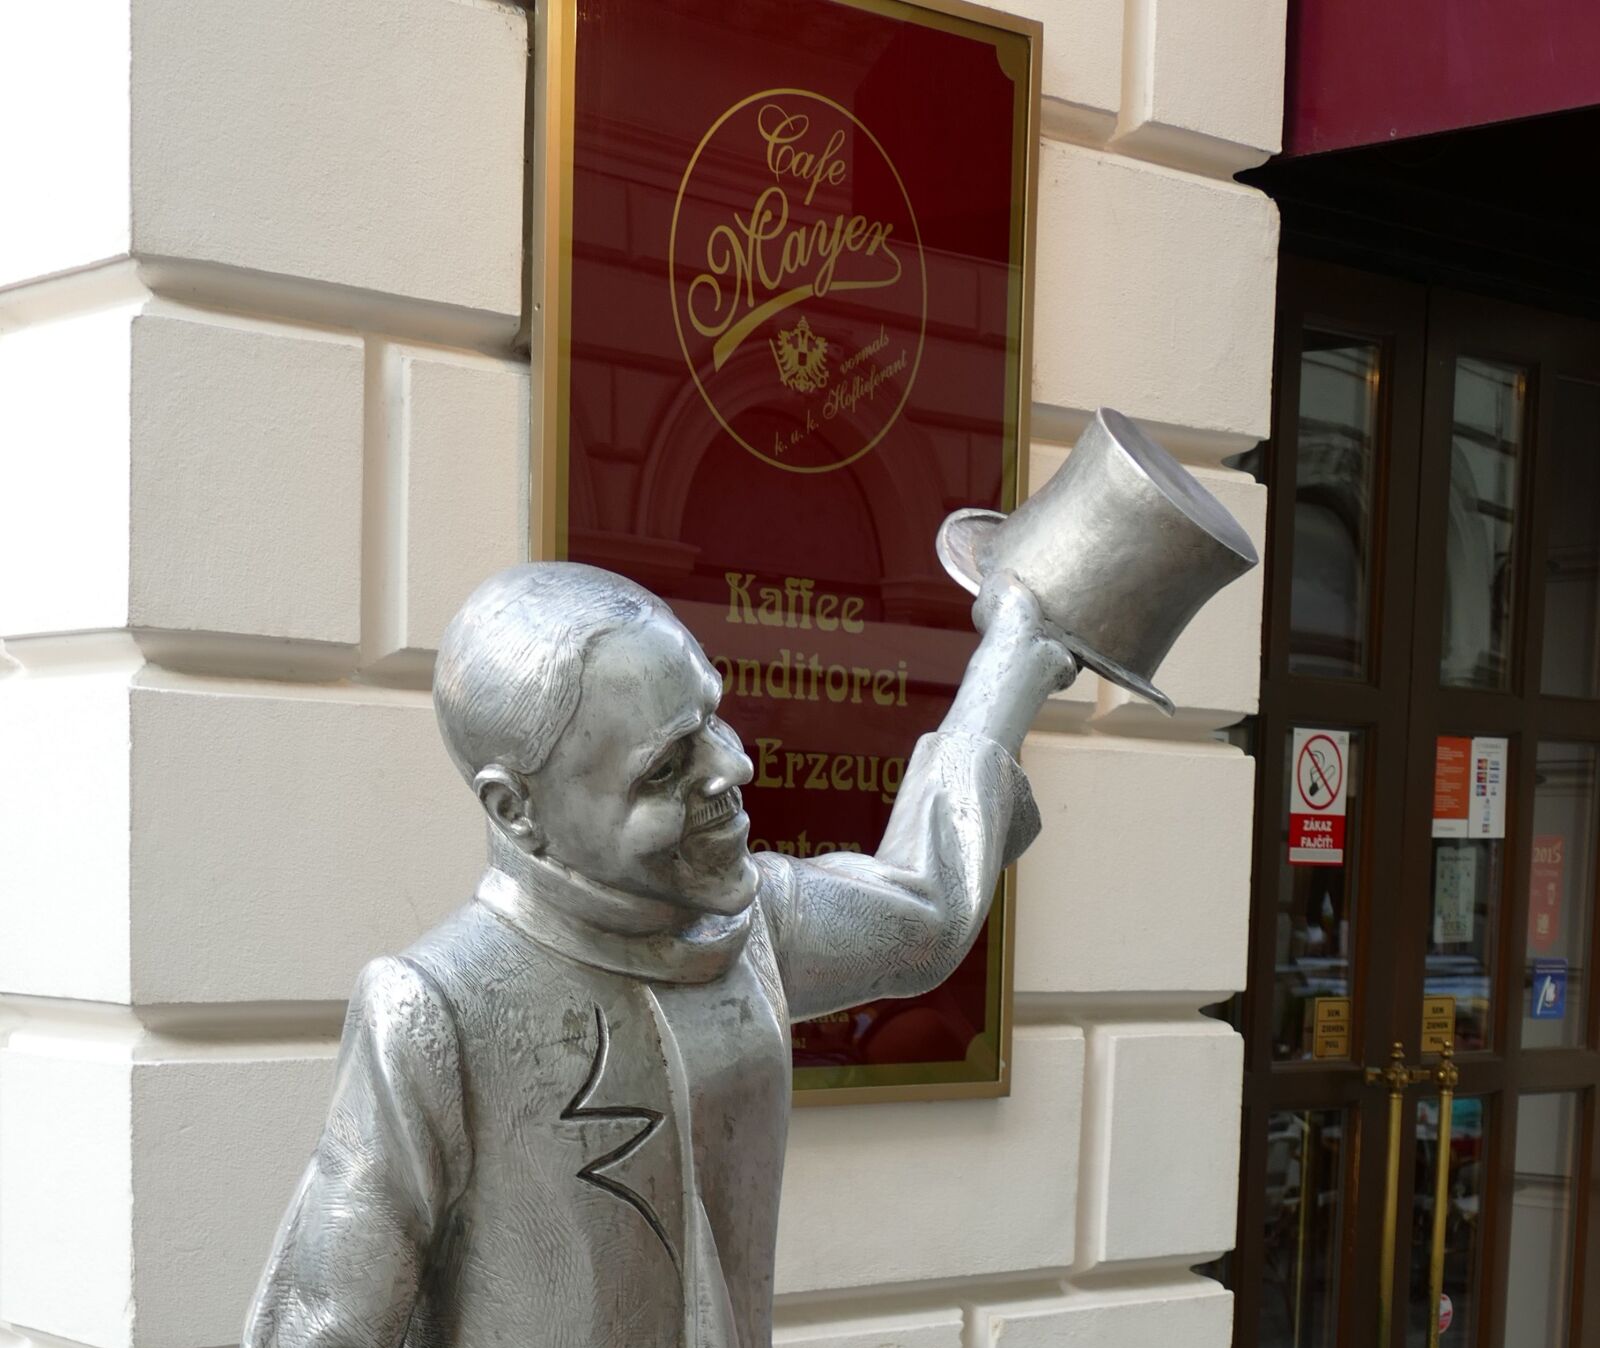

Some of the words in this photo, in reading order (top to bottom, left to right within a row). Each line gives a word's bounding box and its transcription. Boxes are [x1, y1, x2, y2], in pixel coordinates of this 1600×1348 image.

[757, 103, 847, 206] Cafe
[687, 186, 901, 338] Mayer
[839, 323, 890, 374] vormals
[822, 348, 908, 420] Hoflieferant
[724, 571, 865, 634] Kaffee
[702, 645, 909, 707] onditorei
[1302, 816, 1333, 832] ZÁKAZ
[1532, 846, 1562, 864] 2015
